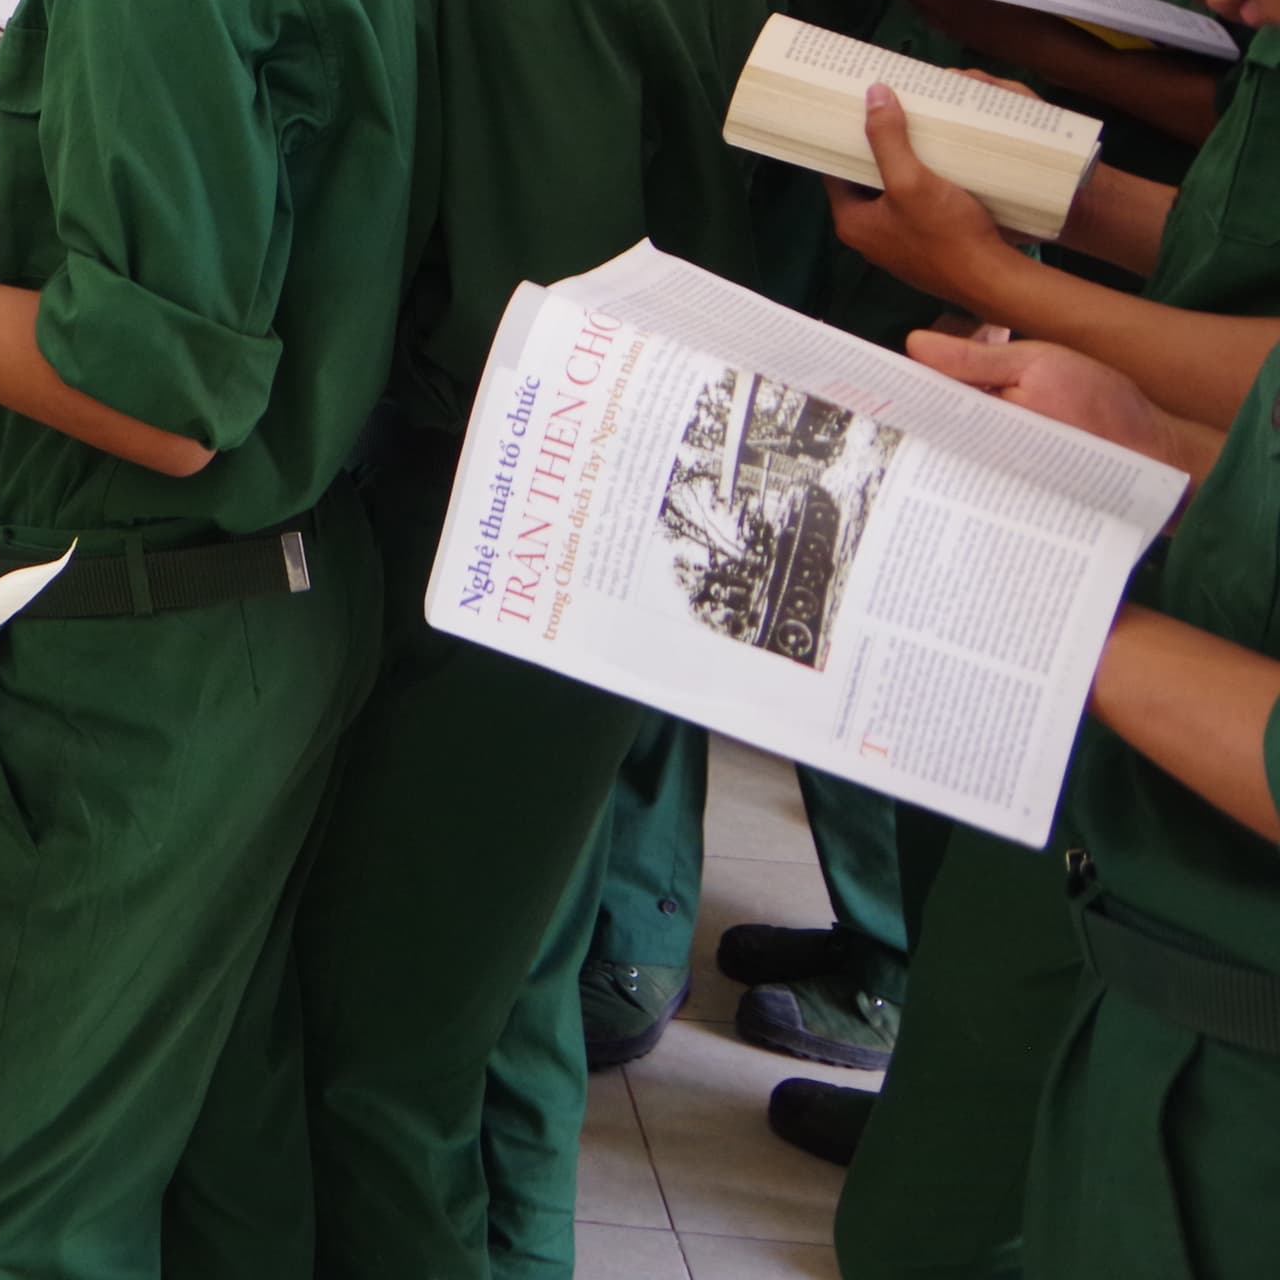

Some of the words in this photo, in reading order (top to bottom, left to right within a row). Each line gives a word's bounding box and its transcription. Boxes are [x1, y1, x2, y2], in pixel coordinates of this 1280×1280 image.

[507, 375, 541, 438] chức
[590, 383, 623, 445] Nguyên
[496, 439, 522, 470] tổ
[580, 450, 604, 483] Tây
[479, 471, 516, 542] thuật
[497, 512, 553, 623] TRẬN
[527, 391, 588, 504] THEN
[568, 484, 594, 530] dịch
[459, 538, 500, 615] Nghệ
[554, 534, 580, 589] Chiến
[543, 596, 572, 641] trong
